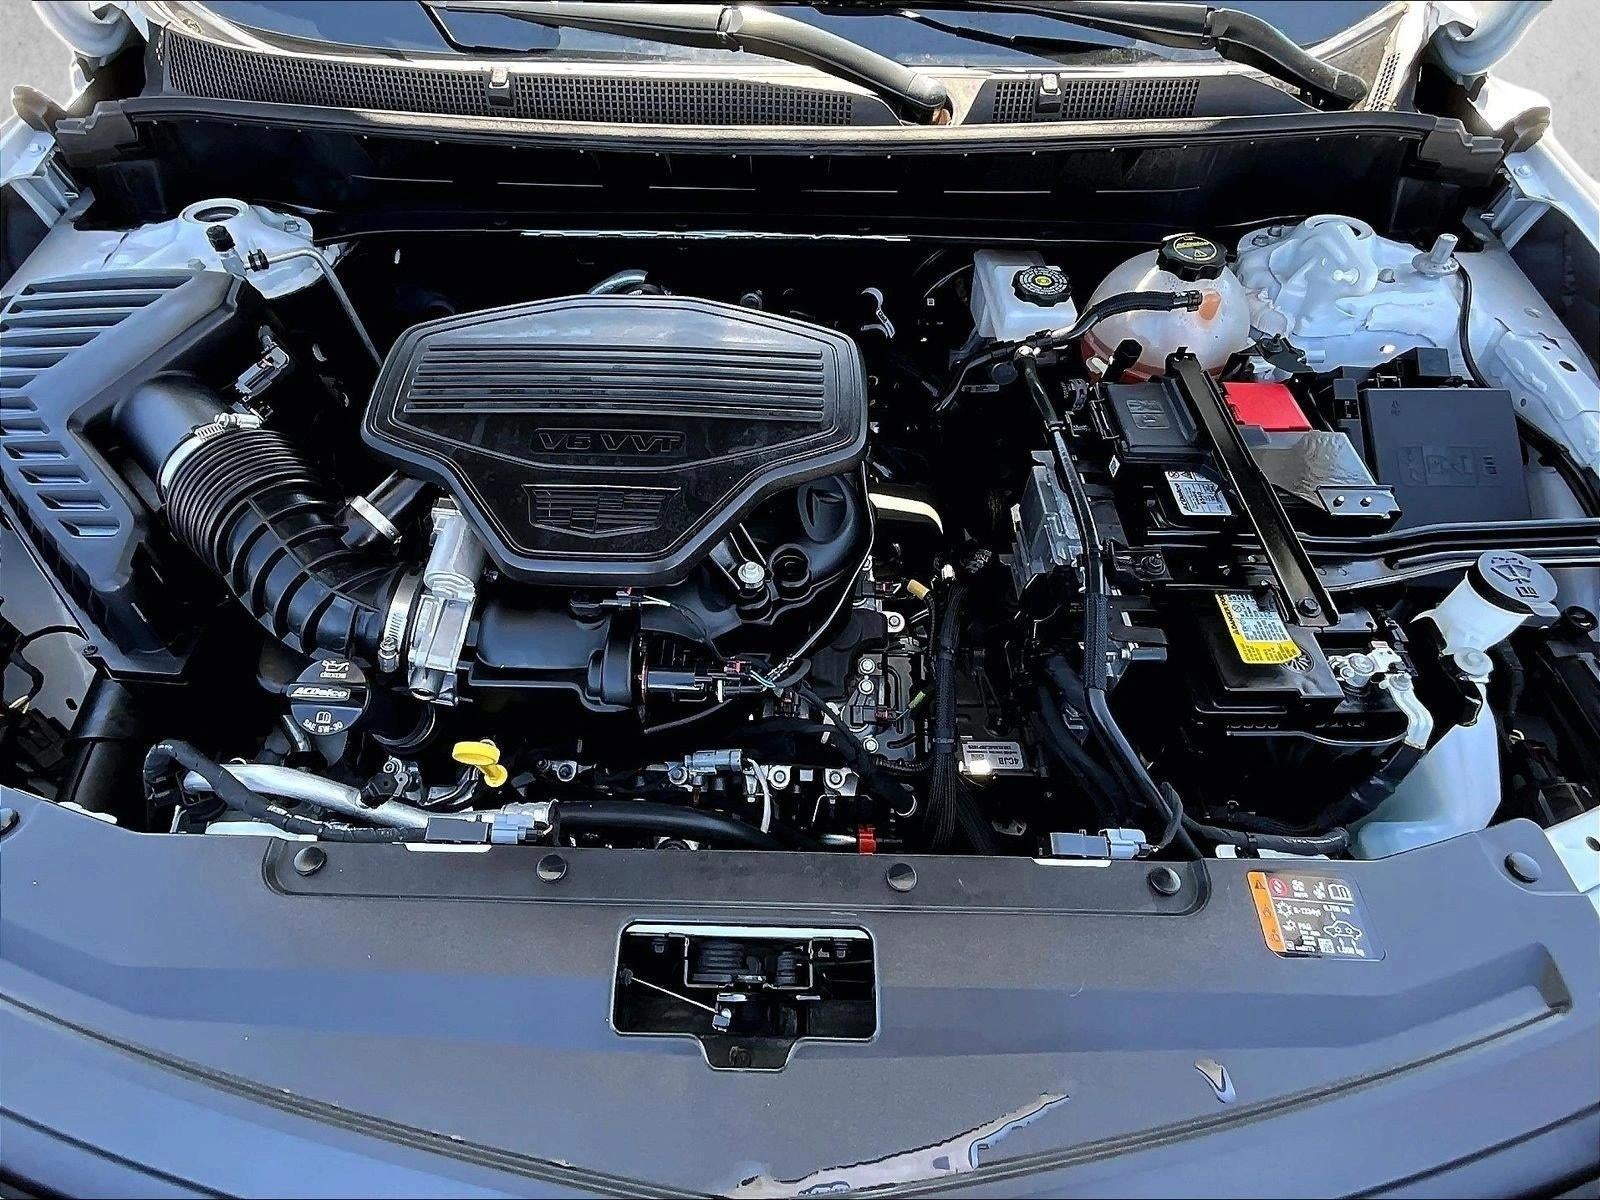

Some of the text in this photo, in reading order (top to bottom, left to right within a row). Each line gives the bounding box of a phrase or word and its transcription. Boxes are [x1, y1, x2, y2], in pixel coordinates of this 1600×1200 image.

[539, 432, 681, 452] V6 VVT
[293, 687, 348, 698] ACDelco
[303, 719, 344, 733] SAE 5W-30
